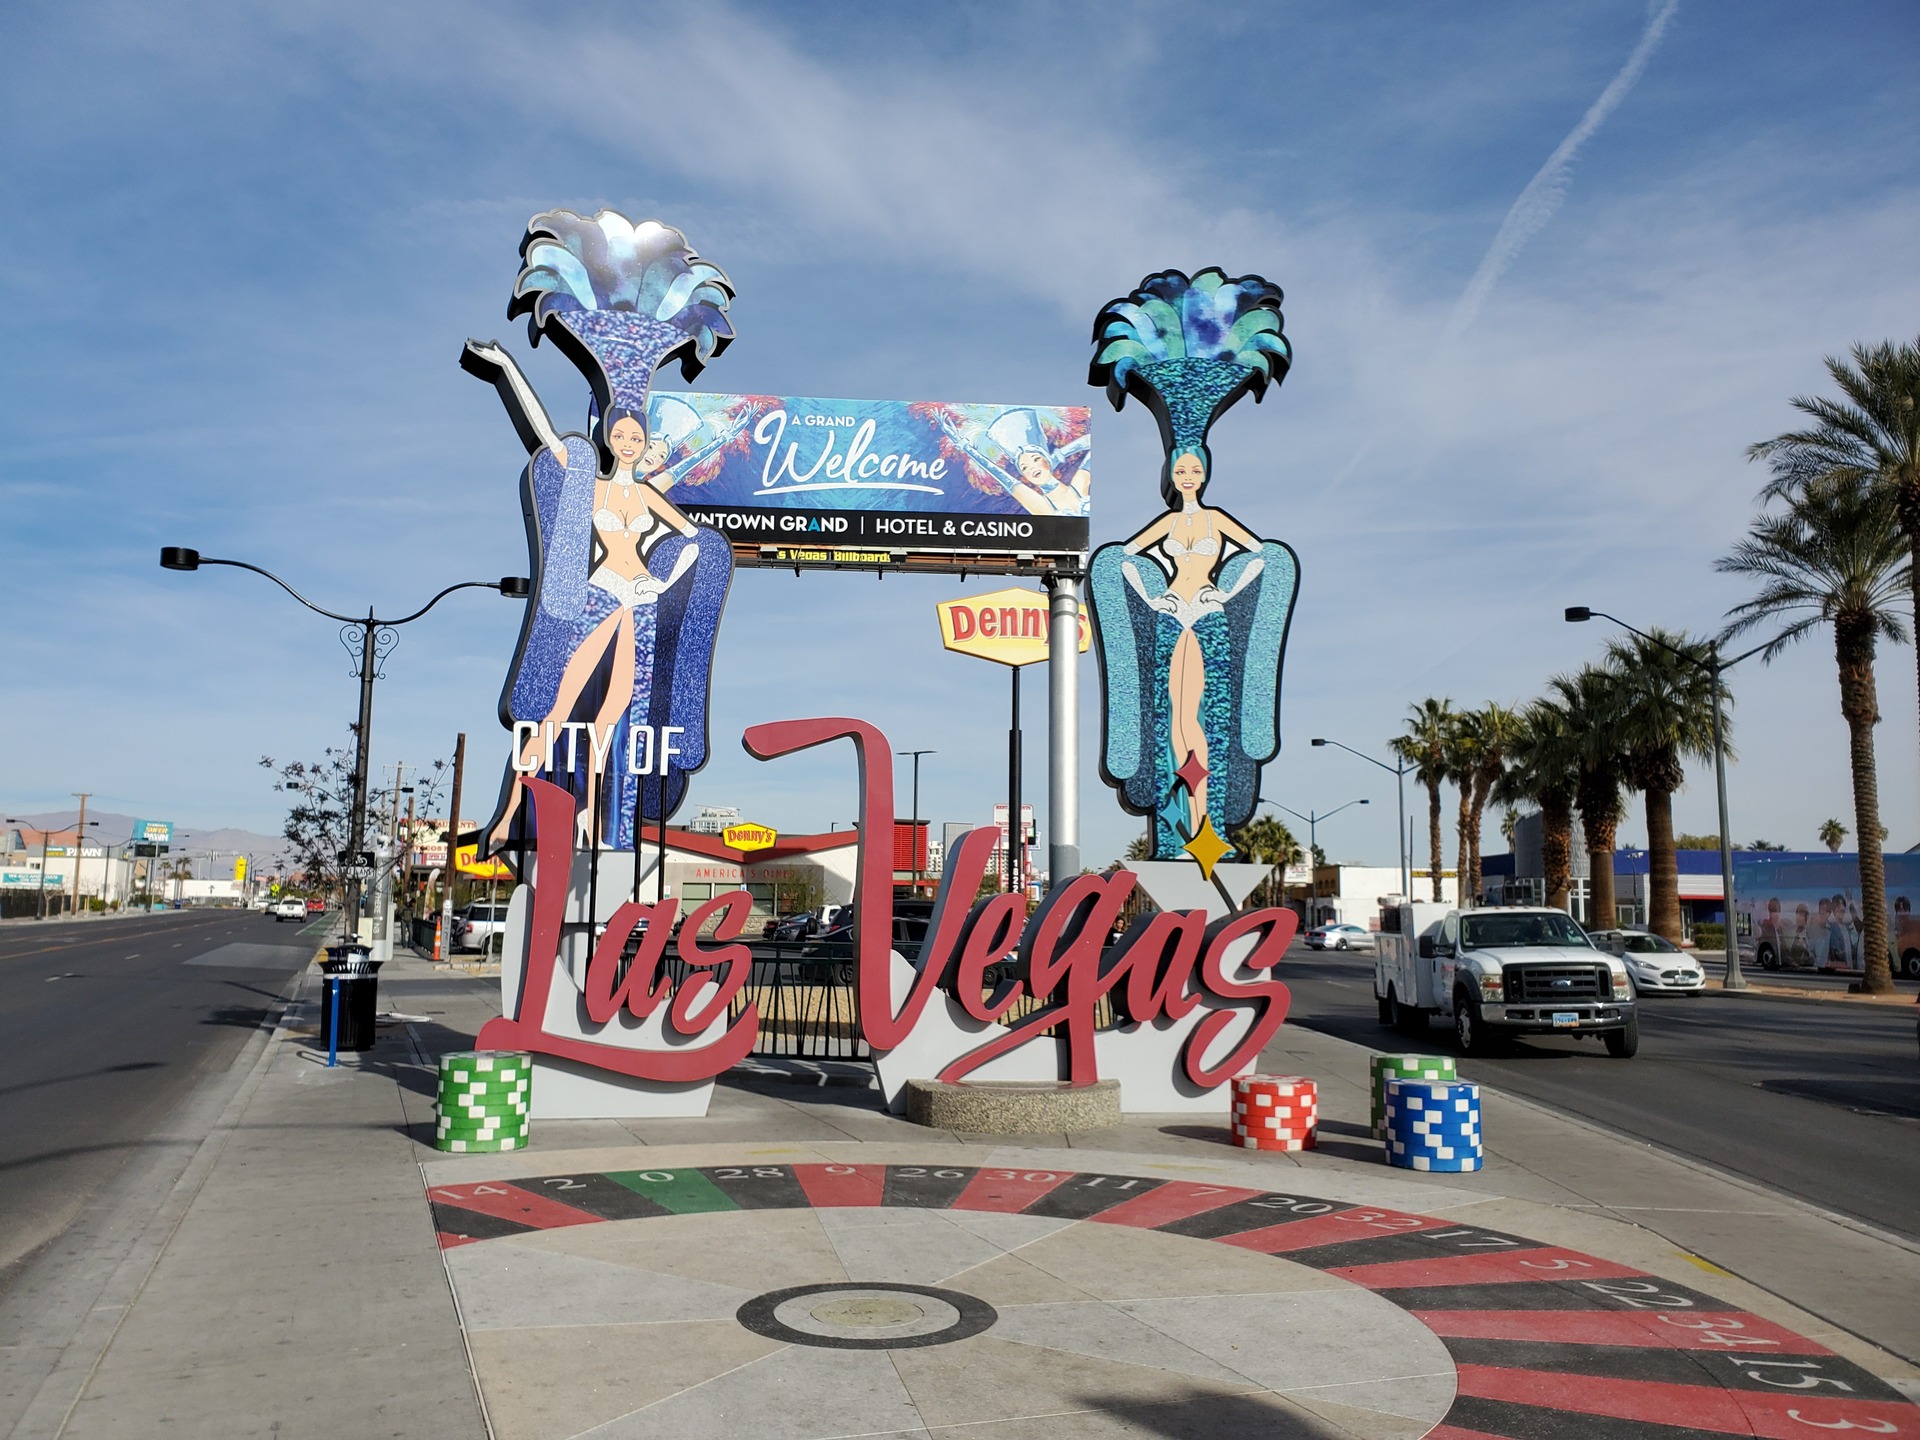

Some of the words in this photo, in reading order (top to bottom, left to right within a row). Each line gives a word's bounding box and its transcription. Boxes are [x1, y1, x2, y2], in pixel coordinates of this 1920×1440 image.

[791, 415, 801, 425] A
[805, 415, 855, 427] GRAND
[754, 410, 948, 488] Welcome
[688, 512, 774, 530] WNTOWN
[780, 515, 848, 533] GRAND
[876, 518, 938, 535] HOTEL
[942, 520, 957, 536] &
[960, 520, 1033, 538] CASINO
[949, 605, 1089, 645] Denns
[512, 720, 616, 774] CITY
[628, 725, 685, 777] OF
[727, 829, 773, 844] Denny's
[696, 868, 756, 878] AMERICA'S
[475, 776, 758, 1082] Las
[742, 717, 1299, 1088] Vegas
[639, 1172, 675, 1182] 0
[714, 1167, 785, 1181] 28
[824, 1165, 857, 1176] 9
[895, 1167, 965, 1179] 26
[985, 1170, 1057, 1183] 30
[544, 1178, 587, 1191] 2
[1083, 1176, 1138, 1190] 11
[437, 1184, 508, 1200] 14
[1189, 1187, 1229, 1197] 7
[1247, 1197, 1333, 1214] 20
[1335, 1211, 1422, 1230] 32
[1421, 1230, 1519, 1248] 17
[1519, 1258, 1593, 1270] 5
[1580, 1281, 1694, 1308] 22
[1657, 1314, 1781, 1347] 34
[1728, 1356, 1856, 1393] 15
[1787, 1409, 1899, 1434] 3
